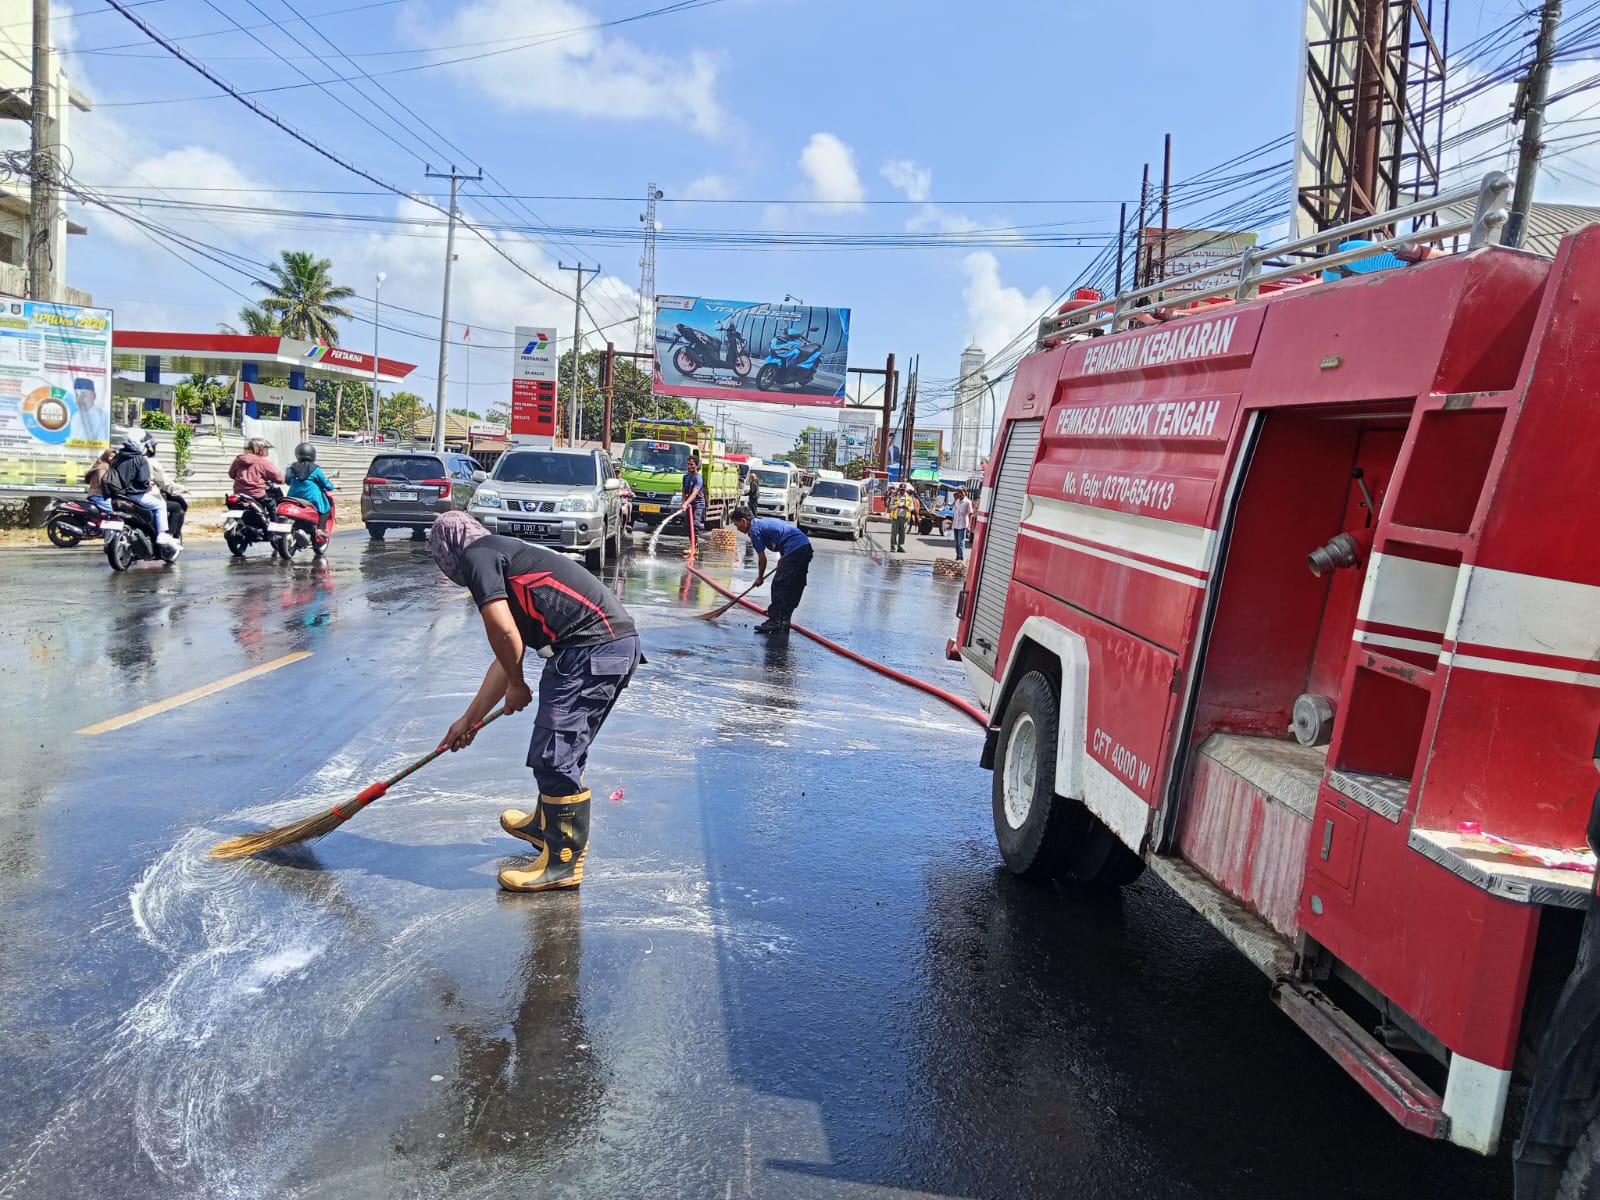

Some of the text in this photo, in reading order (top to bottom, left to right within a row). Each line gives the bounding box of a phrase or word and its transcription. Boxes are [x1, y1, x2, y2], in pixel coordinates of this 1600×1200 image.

[330, 349, 363, 363] PERTAMINA
[1082, 317, 1237, 375] PEMADAM KEBAKARAN
[1056, 400, 1220, 436] PEMKAB LOMBOK TENGAH
[1063, 473, 1077, 495] No.
[1102, 475, 1175, 511] 0370-654113
[1093, 728, 1150, 789] CFT 4000 W
